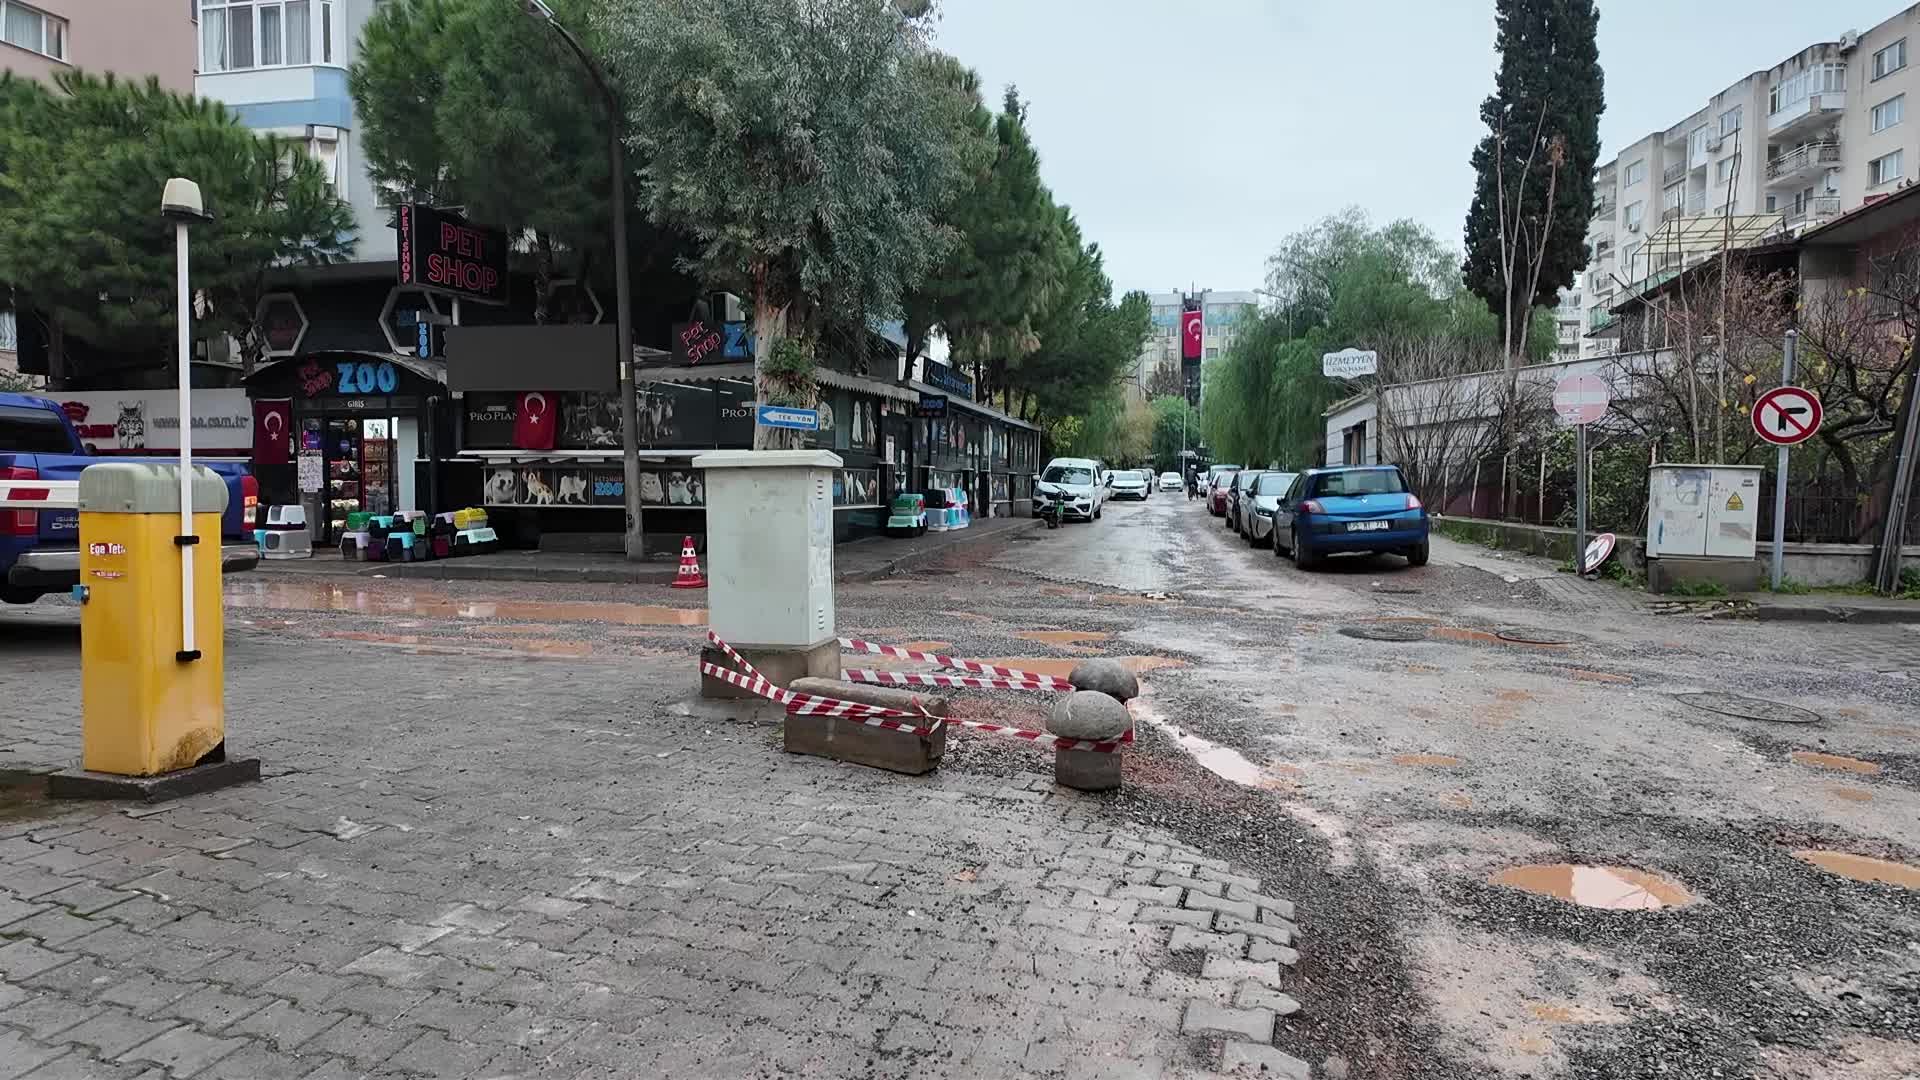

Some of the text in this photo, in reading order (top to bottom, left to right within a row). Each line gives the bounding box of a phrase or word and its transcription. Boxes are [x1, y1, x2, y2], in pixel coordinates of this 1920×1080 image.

[442, 223, 487, 260] PET
[427, 253, 497, 293] SHOP
[337, 362, 397, 394] ZOO
[469, 412, 492, 421] PRO
[721, 408, 746, 418] PRO
[796, 415, 811, 423] YÖN
[594, 482, 624, 496] ZOO
[90, 543, 105, 555] Ege
